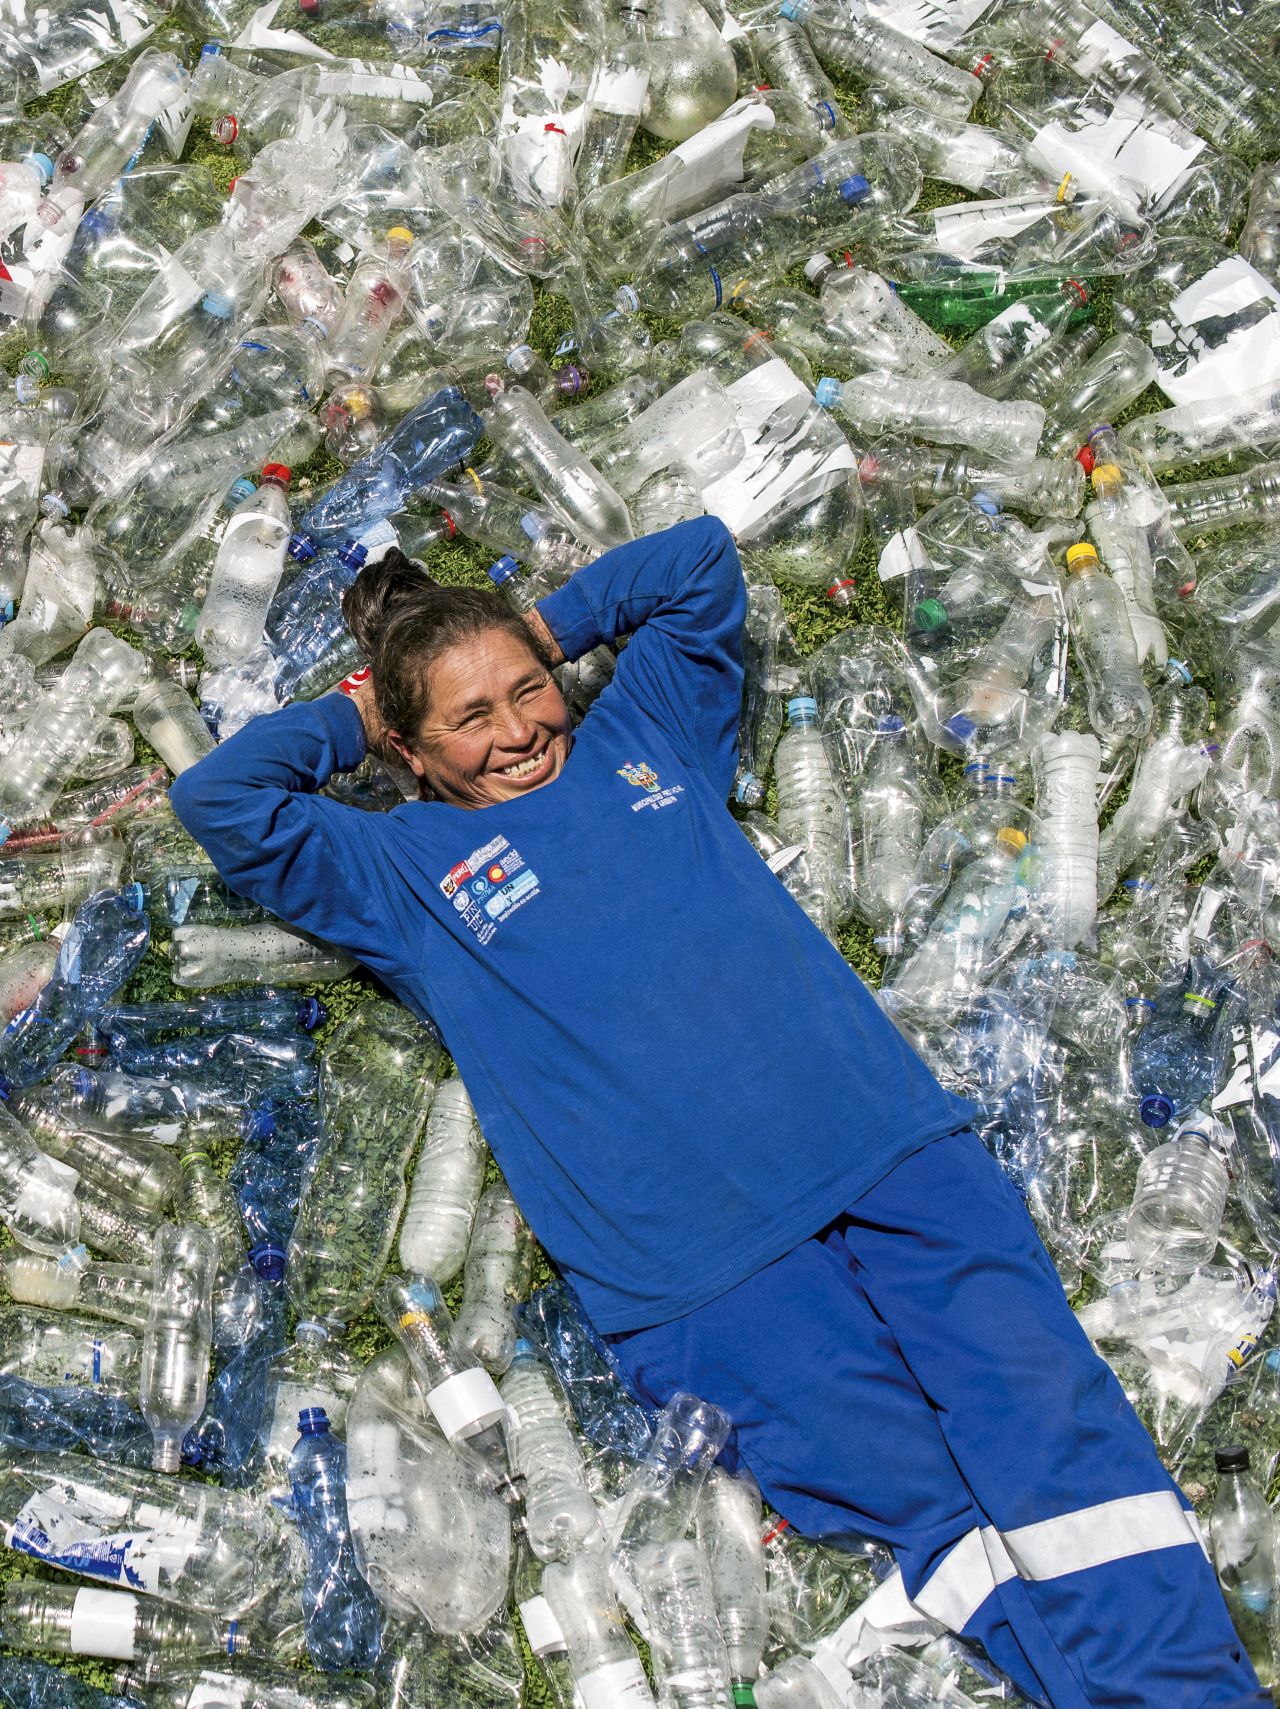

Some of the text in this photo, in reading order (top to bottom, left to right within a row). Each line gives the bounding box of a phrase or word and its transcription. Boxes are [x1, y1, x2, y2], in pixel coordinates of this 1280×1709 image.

[499, 849, 519, 866] aecid
[453, 863, 468, 880] PERÚ
[476, 885, 496, 904] PNUMA
[501, 883, 514, 896] UN
